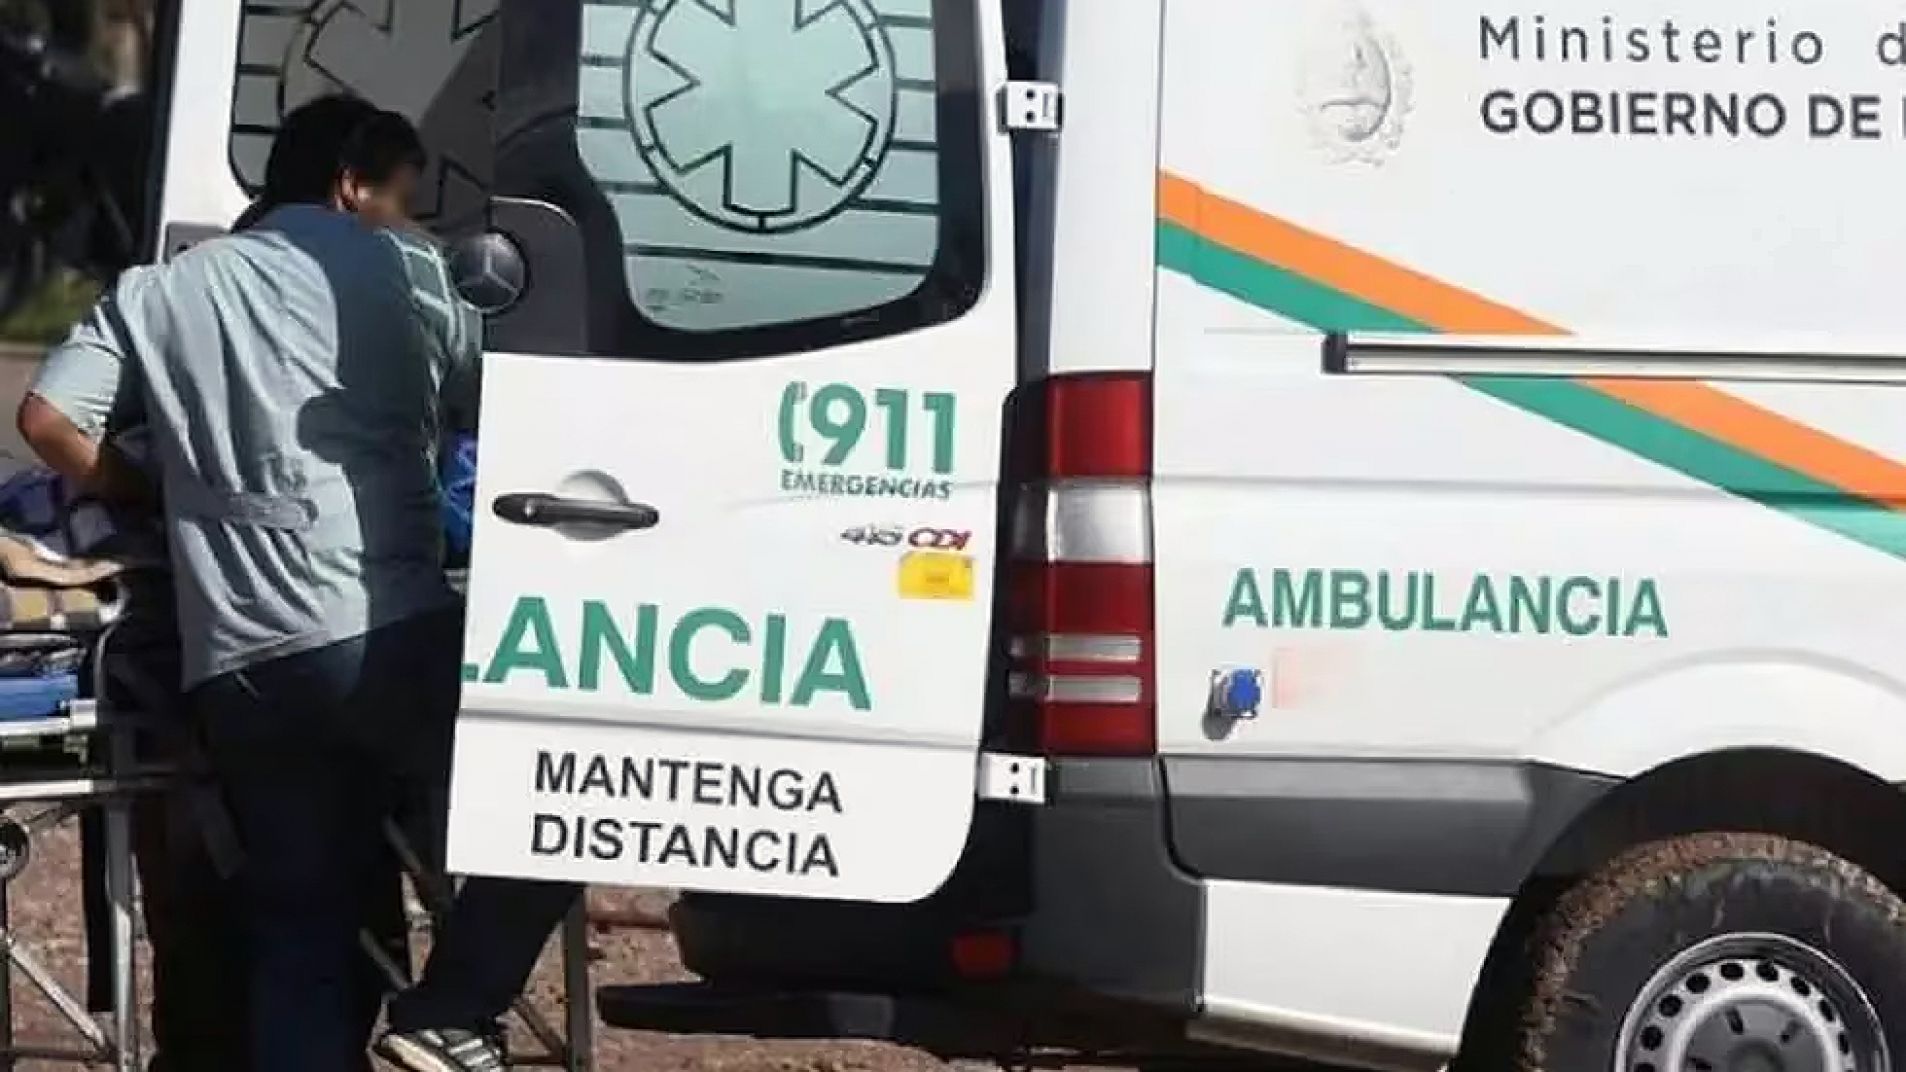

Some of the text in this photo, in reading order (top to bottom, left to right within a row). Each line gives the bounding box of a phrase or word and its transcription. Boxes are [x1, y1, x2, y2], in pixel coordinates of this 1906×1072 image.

[1480, 15, 1823, 64] Ministerio
[1481, 89, 1786, 137] GOBIERNO
[1808, 94, 1881, 139] DE
[781, 470, 951, 499] EMERGENCIAS
[1222, 567, 1669, 638] AMBULANCIA
[534, 750, 843, 814] MANTENGA
[530, 813, 840, 877] DISTANCIA
